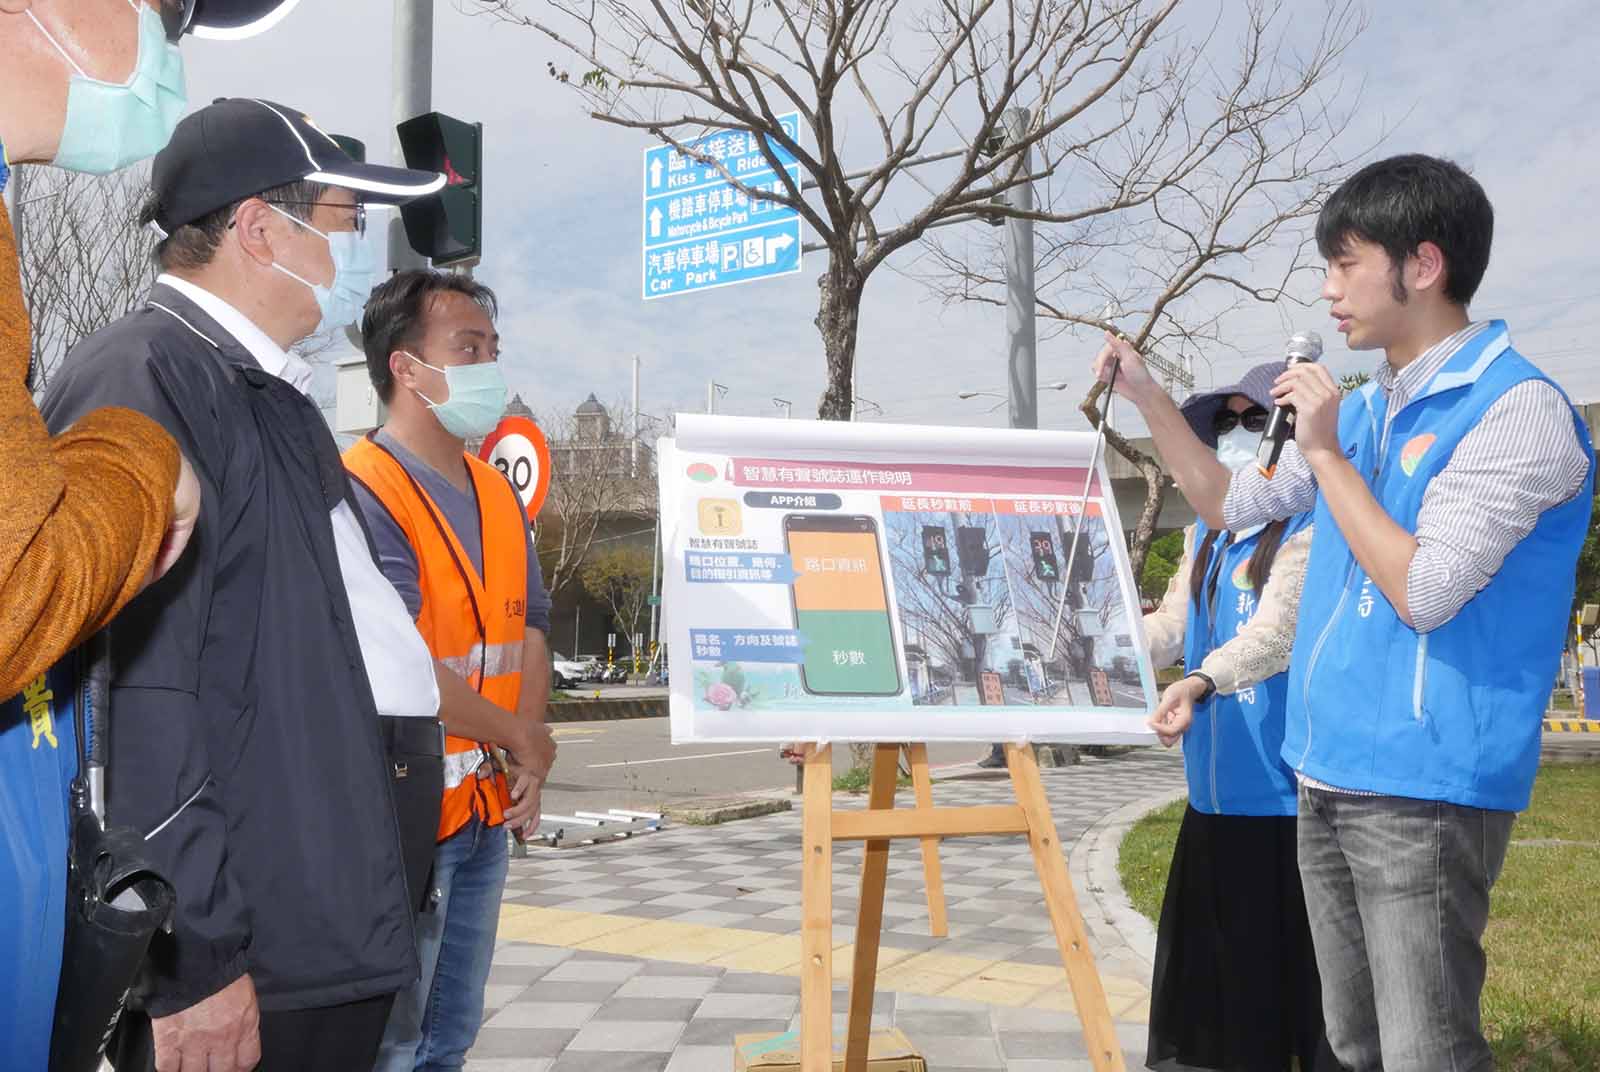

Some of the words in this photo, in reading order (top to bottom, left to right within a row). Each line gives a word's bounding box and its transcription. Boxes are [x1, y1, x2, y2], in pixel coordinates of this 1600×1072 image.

[668, 172, 696, 188] Kiss
[737, 155, 767, 172] Ride
[648, 240, 720, 276] 汽車停車場
[651, 278, 673, 292] Car
[686, 270, 717, 286] Park
[770, 495, 817, 507] APP介紹
[901, 498, 972, 512] 延長秒數前
[832, 650, 866, 666] 秒數
